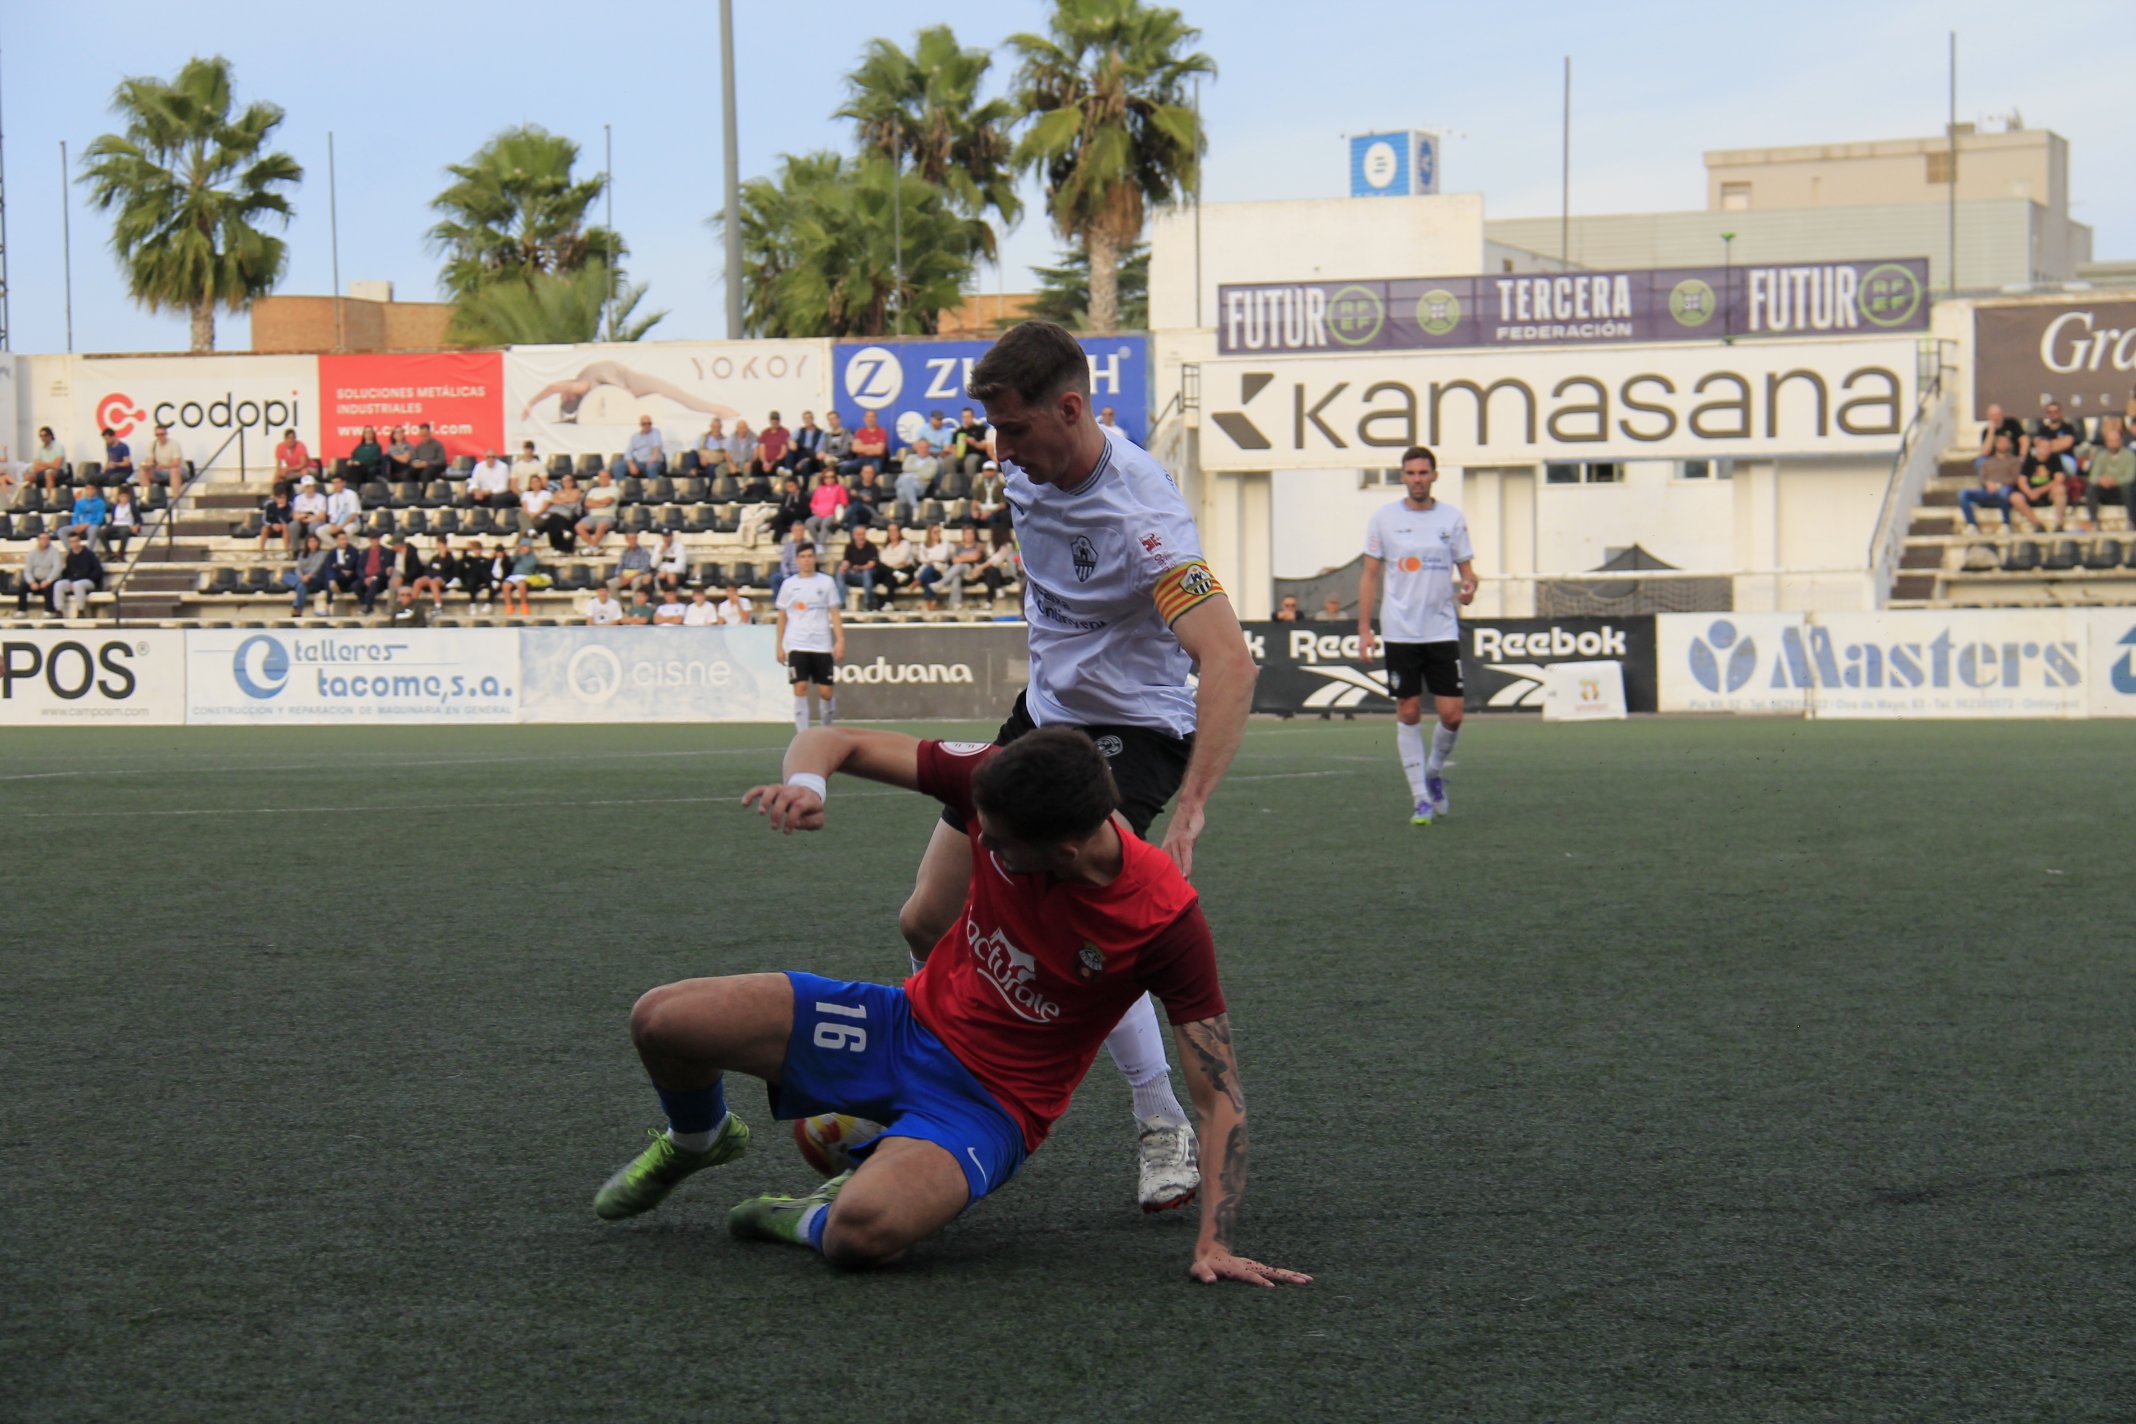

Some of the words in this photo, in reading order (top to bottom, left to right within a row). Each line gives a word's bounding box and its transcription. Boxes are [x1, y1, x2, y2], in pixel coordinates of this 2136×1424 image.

[1497, 275, 1632, 321] TERCERA
[1749, 266, 1858, 331] FUTUR
[1228, 287, 1327, 349] FUTUR
[1497, 320, 1633, 341] FEDERACIÓN
[691, 355, 809, 380] YOKOY
[336, 387, 414, 399] SOLUCIONES
[416, 385, 486, 398] METÁLICAS
[155, 390, 299, 436] codopi
[336, 402, 422, 415] INDUSTRIALES
[294, 639, 407, 662] talleres
[1474, 627, 1627, 658] Reebok
[1769, 625, 2081, 688] Masters
[633, 660, 731, 686] cisne
[813, 1001, 867, 1053] 16
